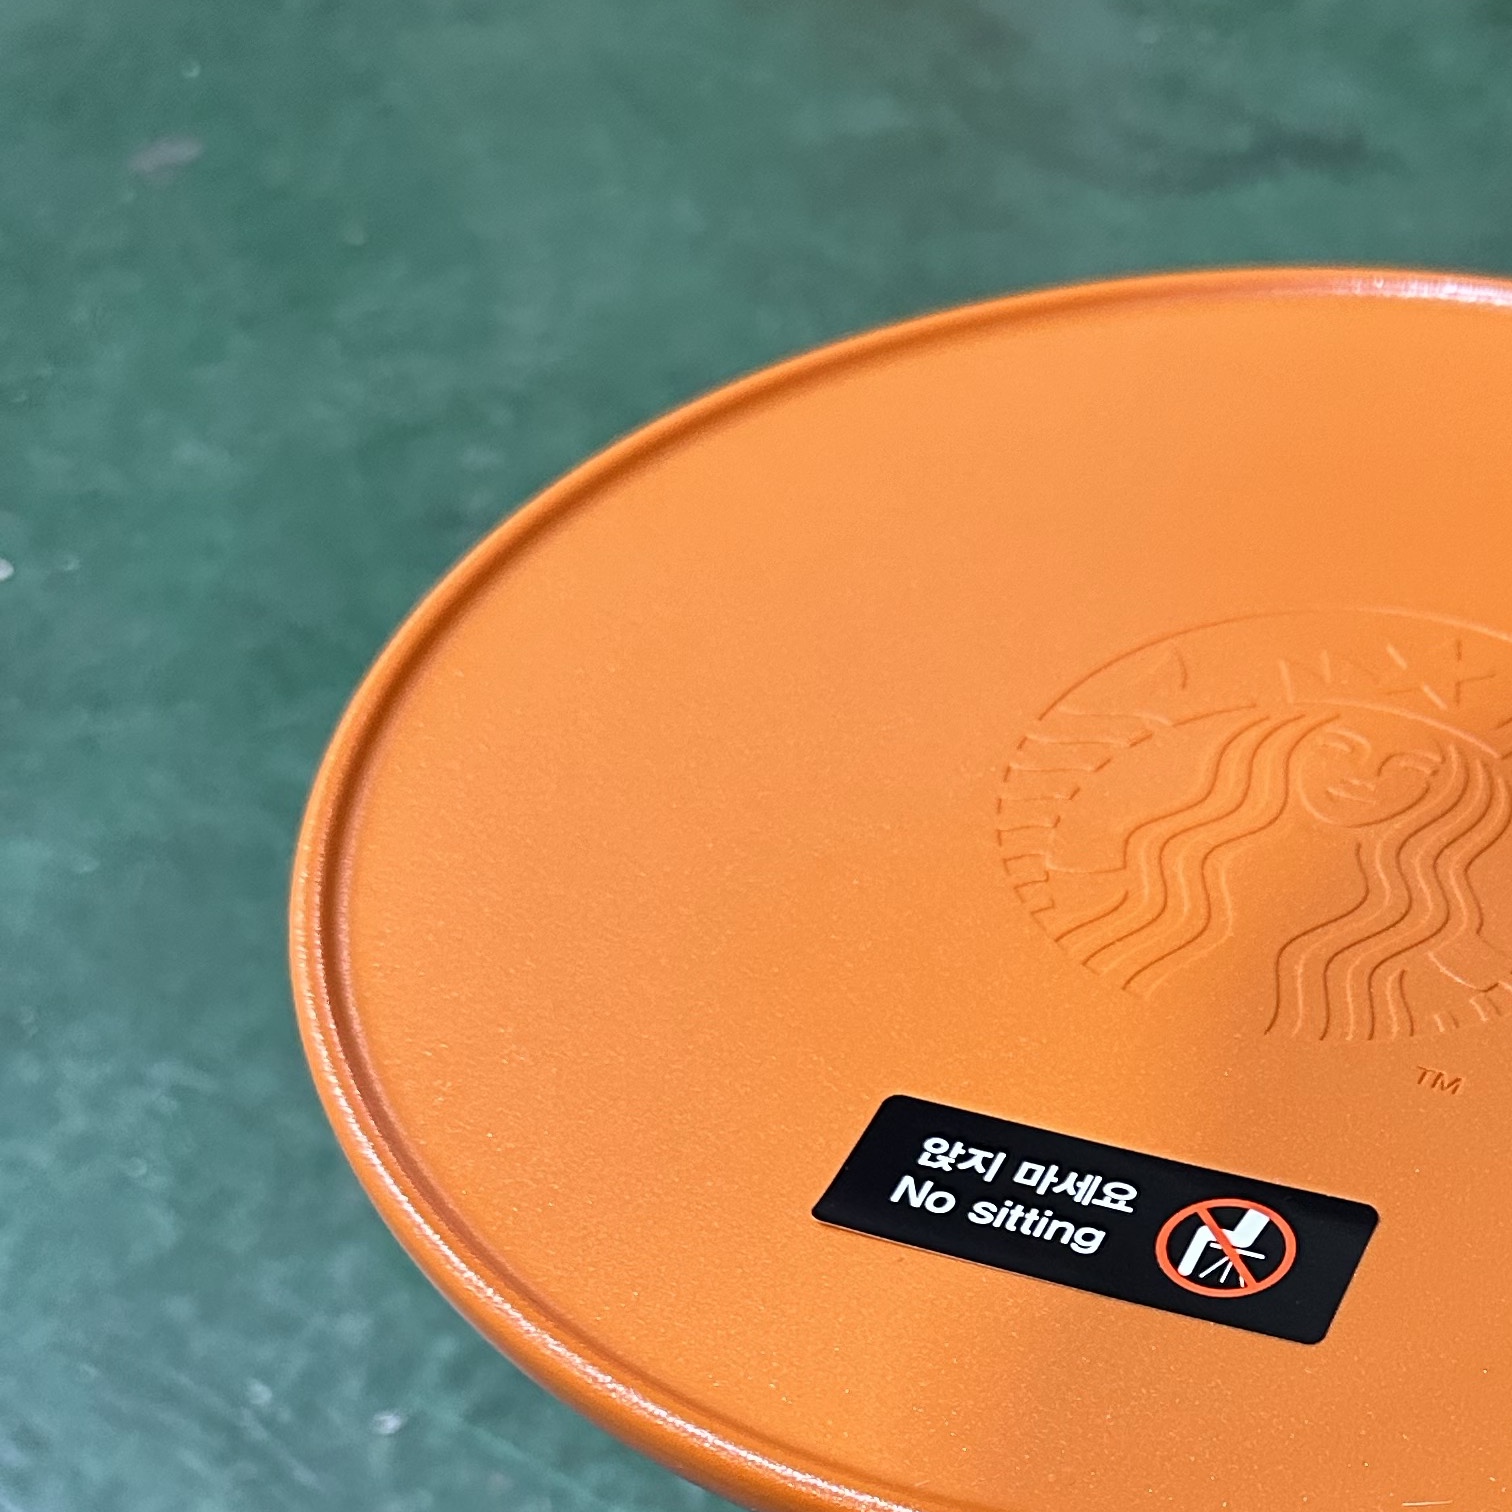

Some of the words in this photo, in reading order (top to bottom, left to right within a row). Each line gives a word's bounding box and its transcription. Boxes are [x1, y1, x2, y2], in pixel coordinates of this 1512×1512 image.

[1416, 1065, 1464, 1095] TM
[917, 1137, 1007, 1183] 앉지
[1012, 1161, 1138, 1214] 마세요
[889, 1174, 956, 1214] No
[967, 1199, 1107, 1255] sitting
